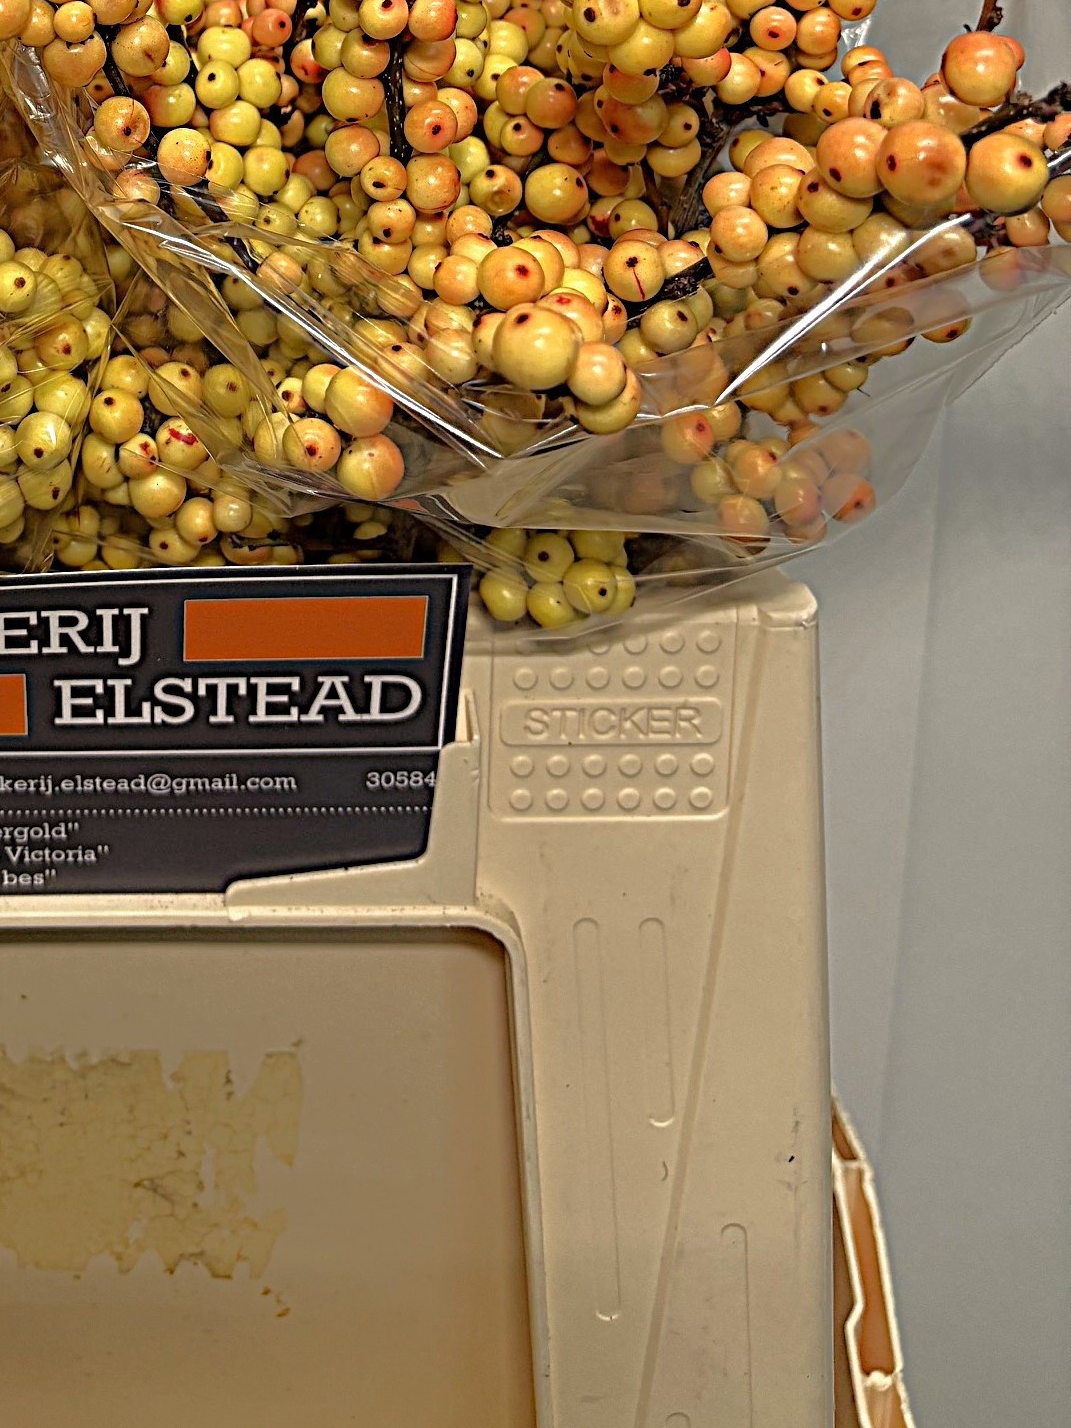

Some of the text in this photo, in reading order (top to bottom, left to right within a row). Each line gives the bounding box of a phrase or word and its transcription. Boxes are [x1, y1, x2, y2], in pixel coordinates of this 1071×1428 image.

[54, 675, 423, 726] ELSTEAD
[523, 705, 704, 739] STICKER
[366, 771, 436, 790] 30584
